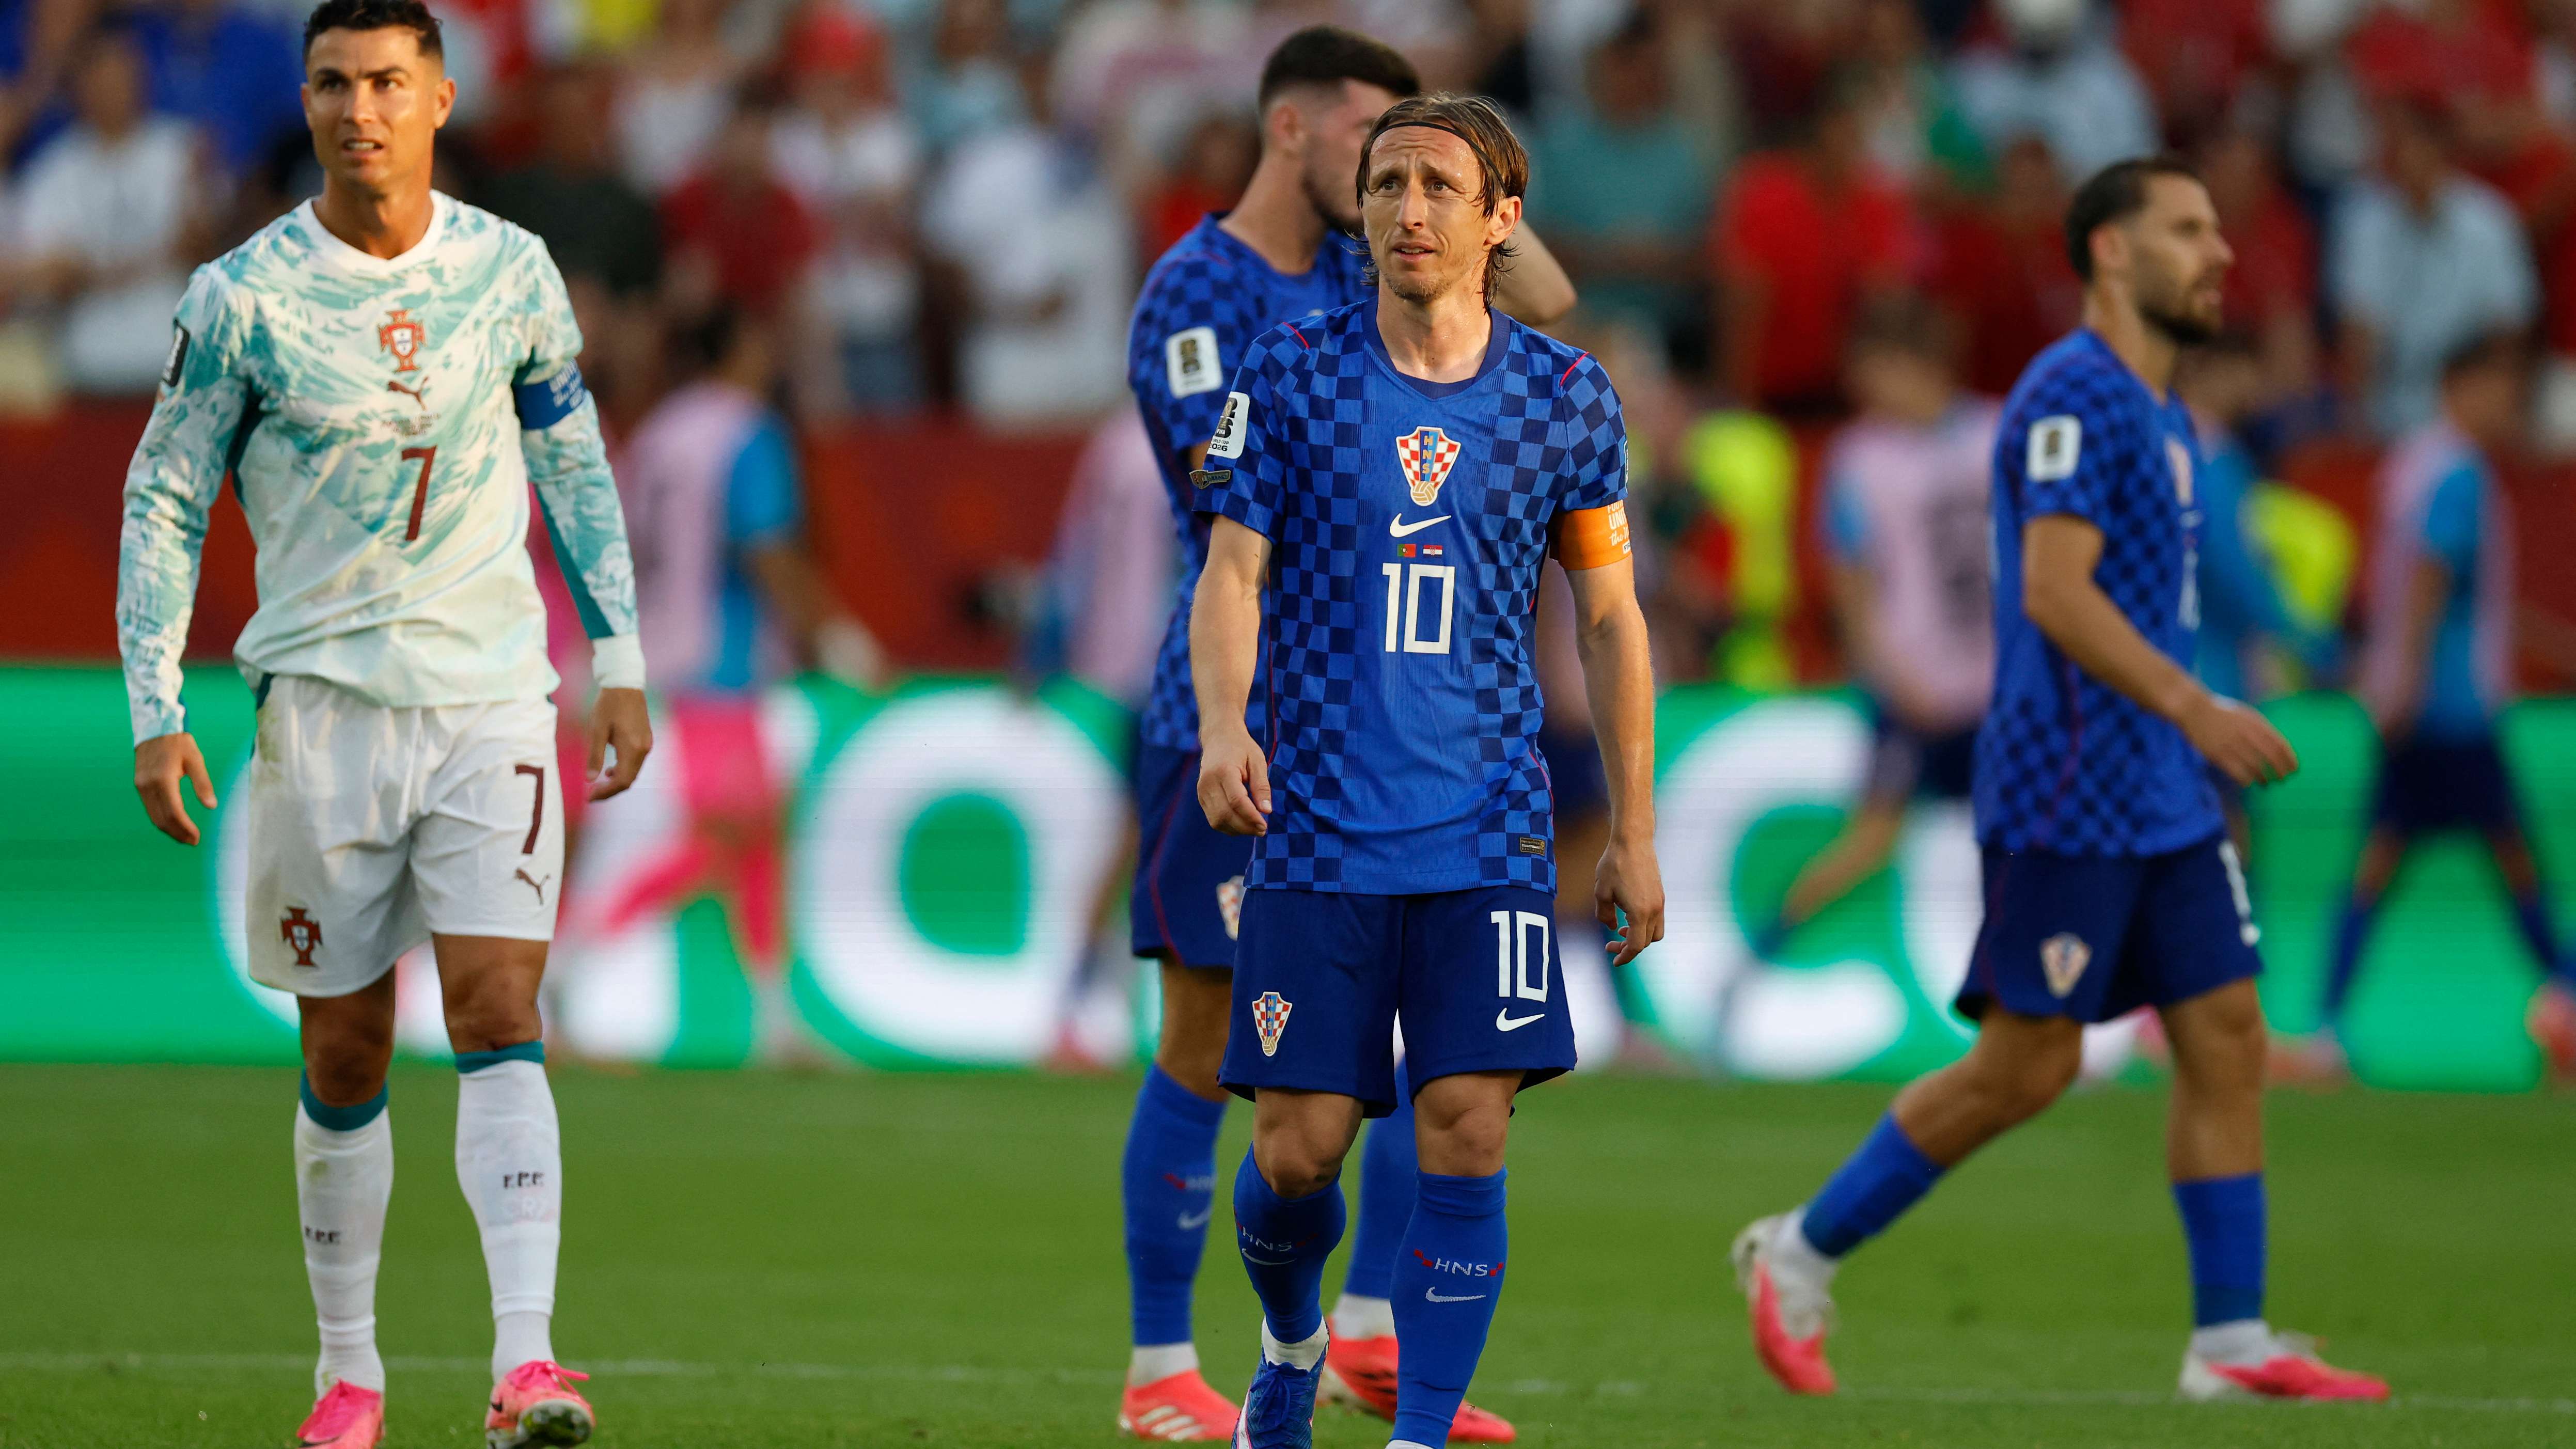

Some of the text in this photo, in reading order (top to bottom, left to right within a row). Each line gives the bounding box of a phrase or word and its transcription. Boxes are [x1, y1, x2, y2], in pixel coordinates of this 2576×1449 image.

[401, 445, 438, 541] 7
[1422, 435, 1434, 474] HNS
[1382, 562, 1455, 654] 10
[515, 764, 544, 854] 7
[1490, 910, 1549, 1003] 10
[1243, 1226, 1292, 1252] HNS
[1434, 1257, 1488, 1277] HNS
